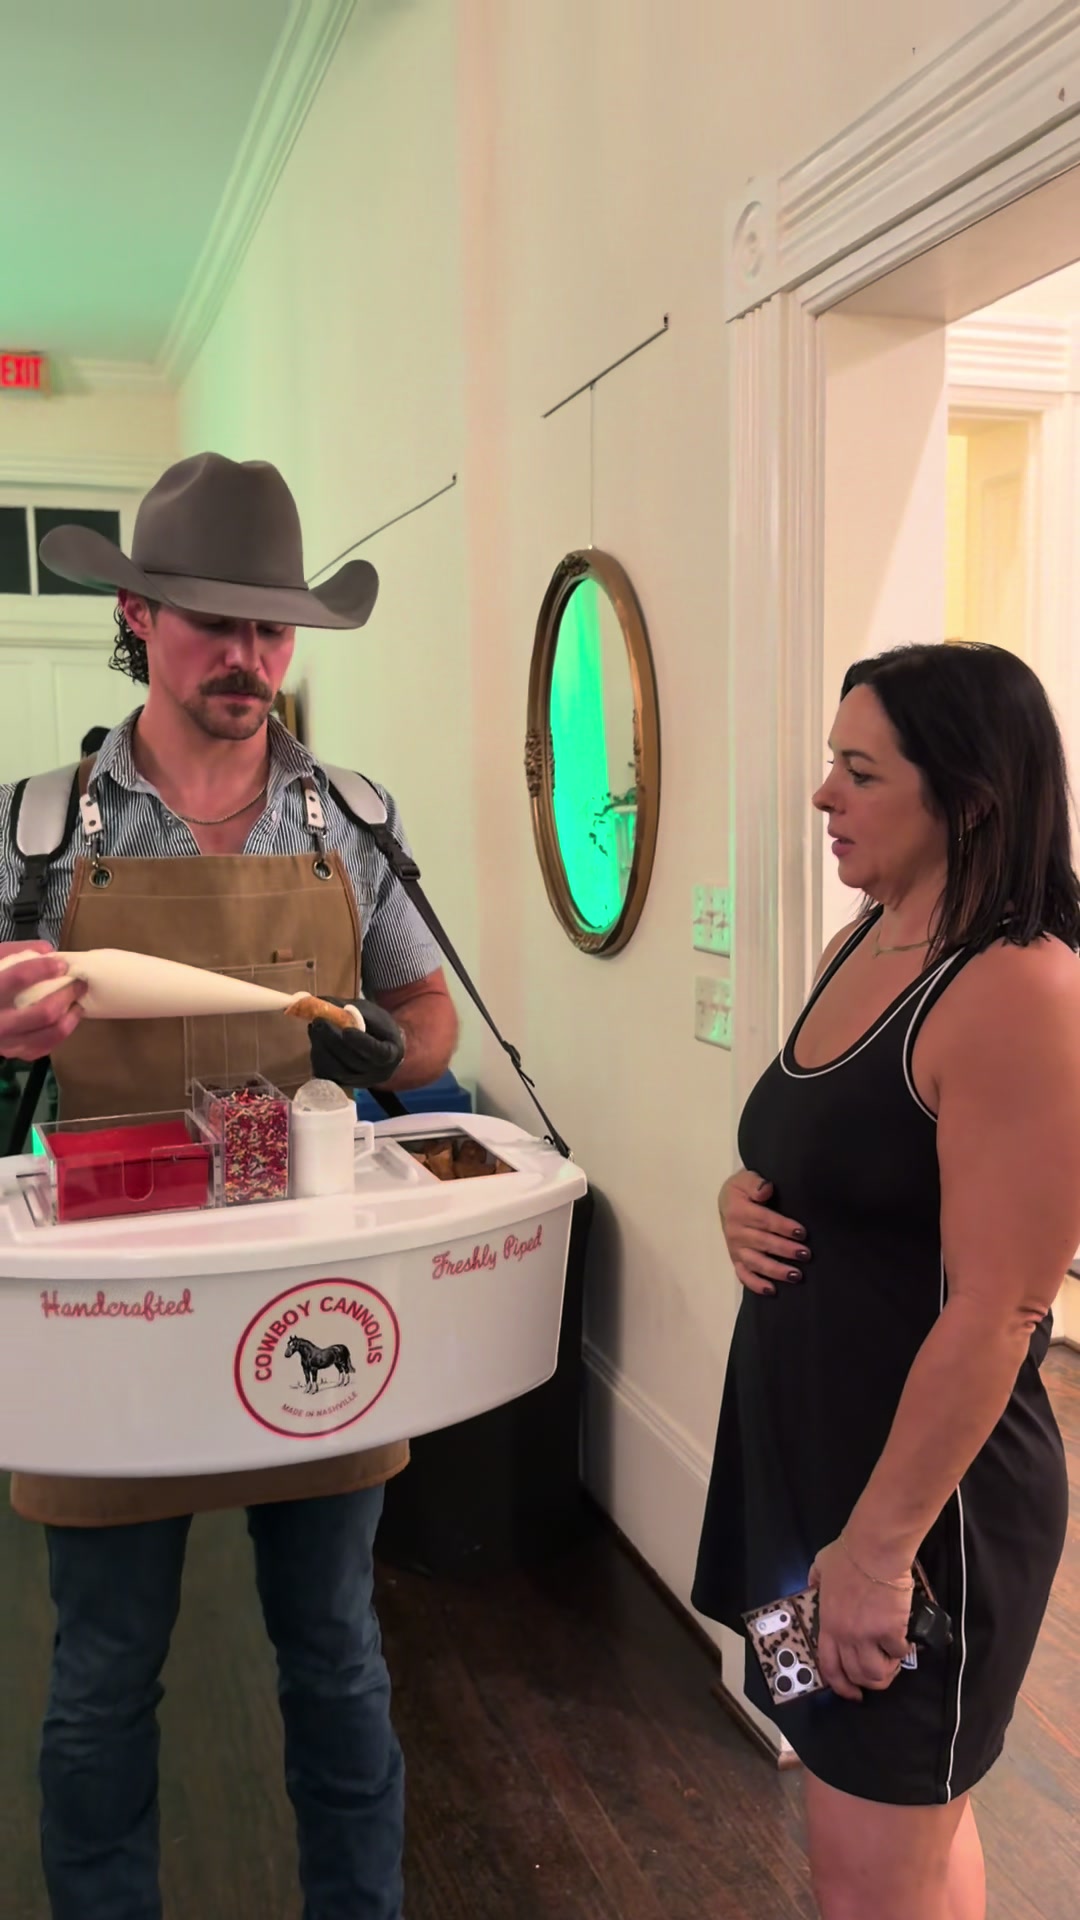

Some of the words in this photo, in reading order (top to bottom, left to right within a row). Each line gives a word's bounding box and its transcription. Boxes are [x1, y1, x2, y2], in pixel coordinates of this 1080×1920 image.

[0, 355, 42, 389] EXIT
[431, 1243, 497, 1279] Freshly
[503, 1224, 542, 1261] Piped
[39, 1288, 194, 1321] Handcrafted
[255, 1299, 311, 1382] COWBOY
[319, 1296, 383, 1364] CANNOLIS
[281, 1403, 304, 1417] MADE
[316, 1391, 358, 1417] NASHVILLE
